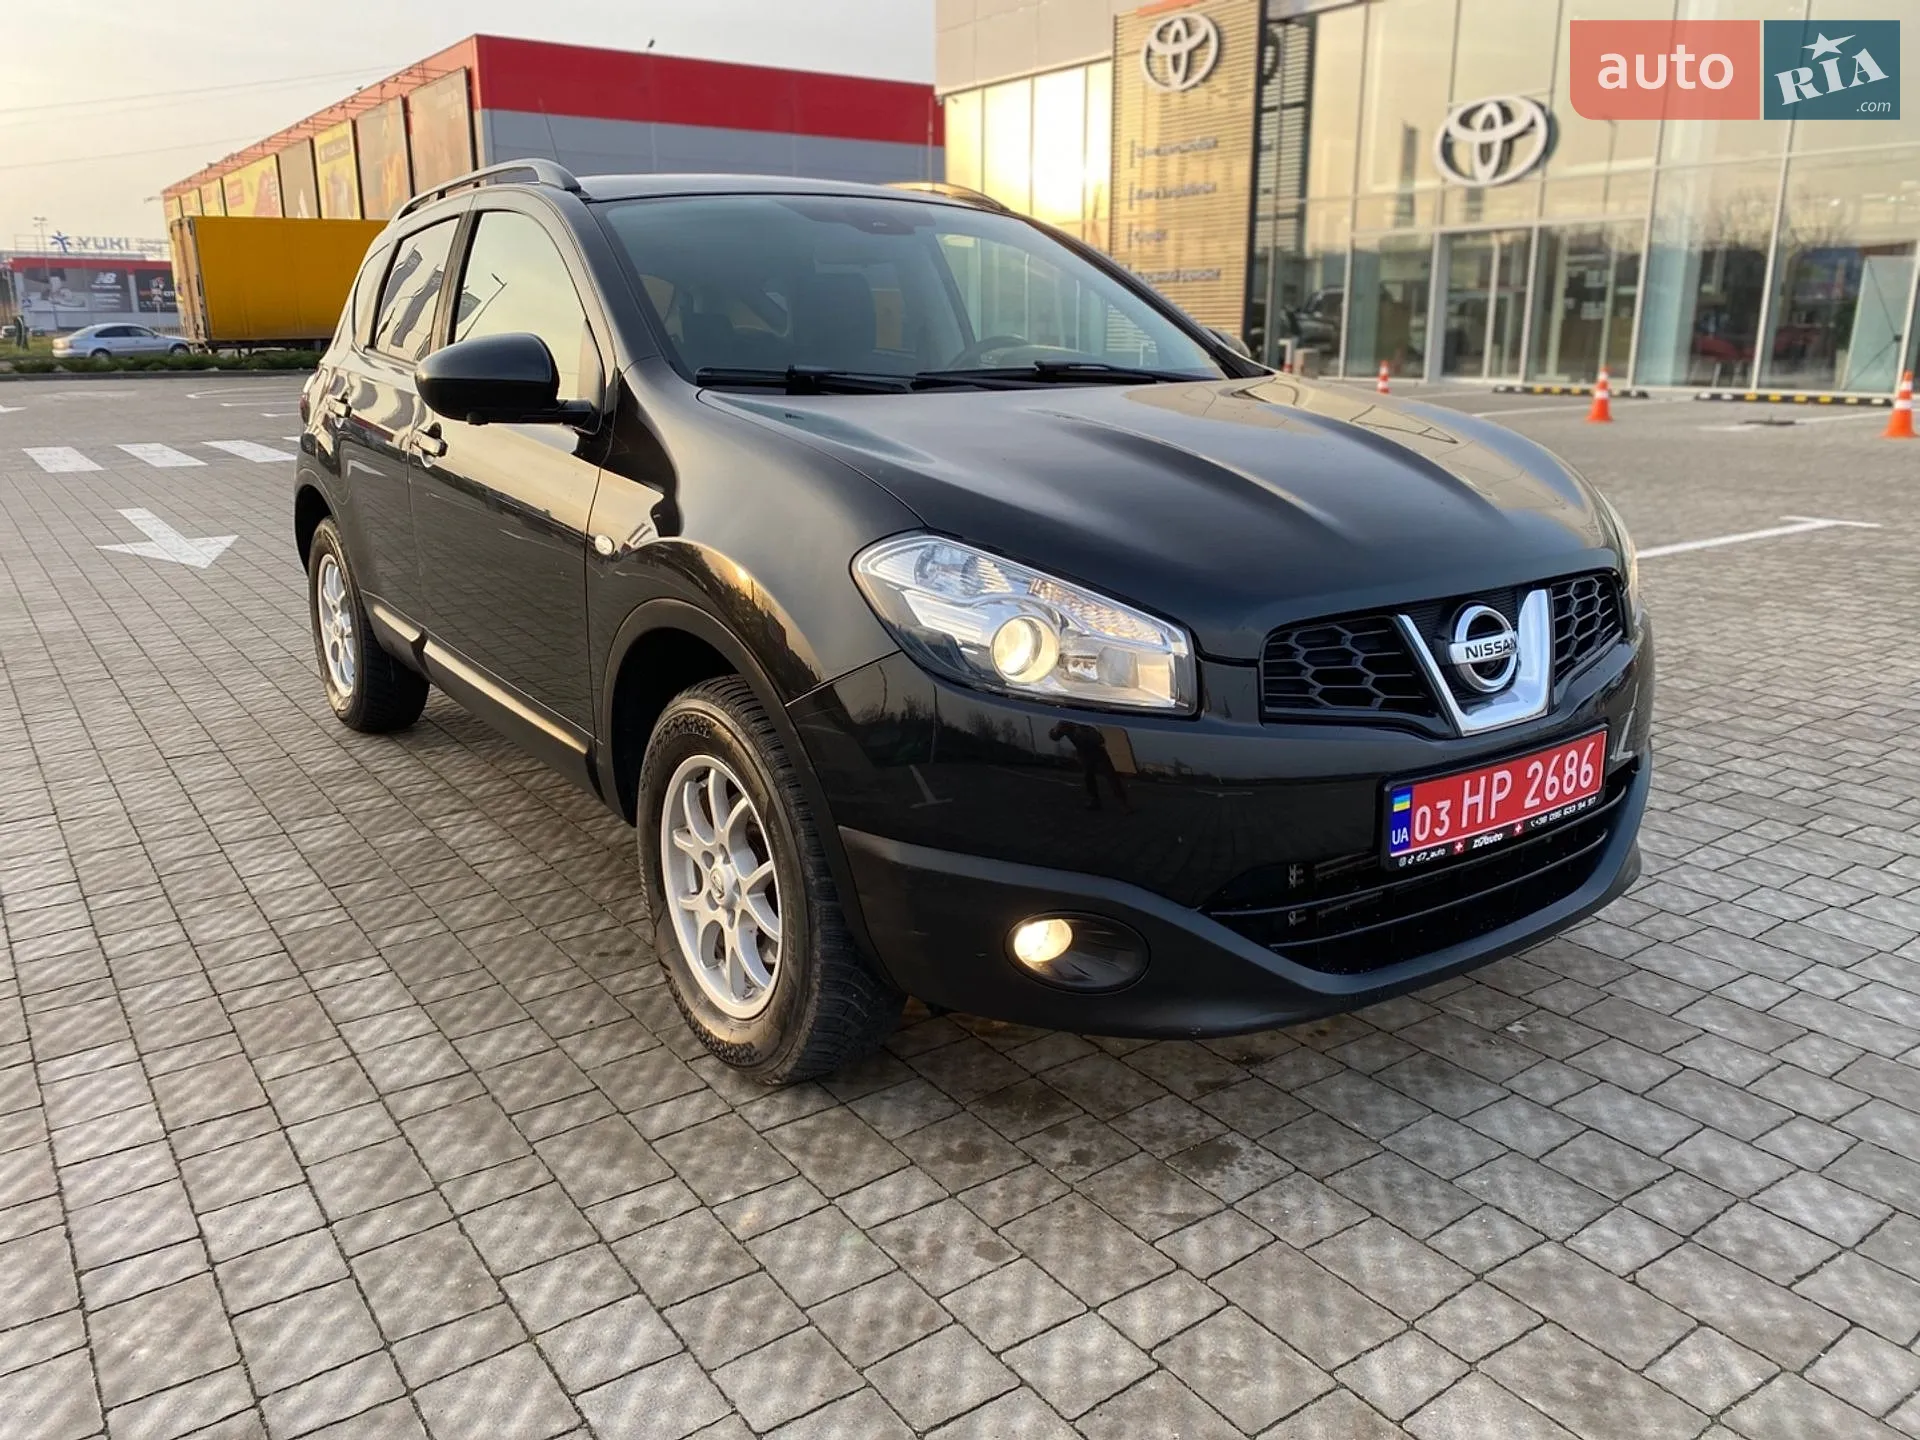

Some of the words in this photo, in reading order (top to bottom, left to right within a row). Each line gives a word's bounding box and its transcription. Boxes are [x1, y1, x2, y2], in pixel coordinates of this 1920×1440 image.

[78, 237, 130, 250] YUKI
[1414, 800, 1451, 841] 03
[1461, 770, 1512, 828] HP
[1524, 742, 1595, 809] 2686
[1391, 827, 1409, 845] UA
